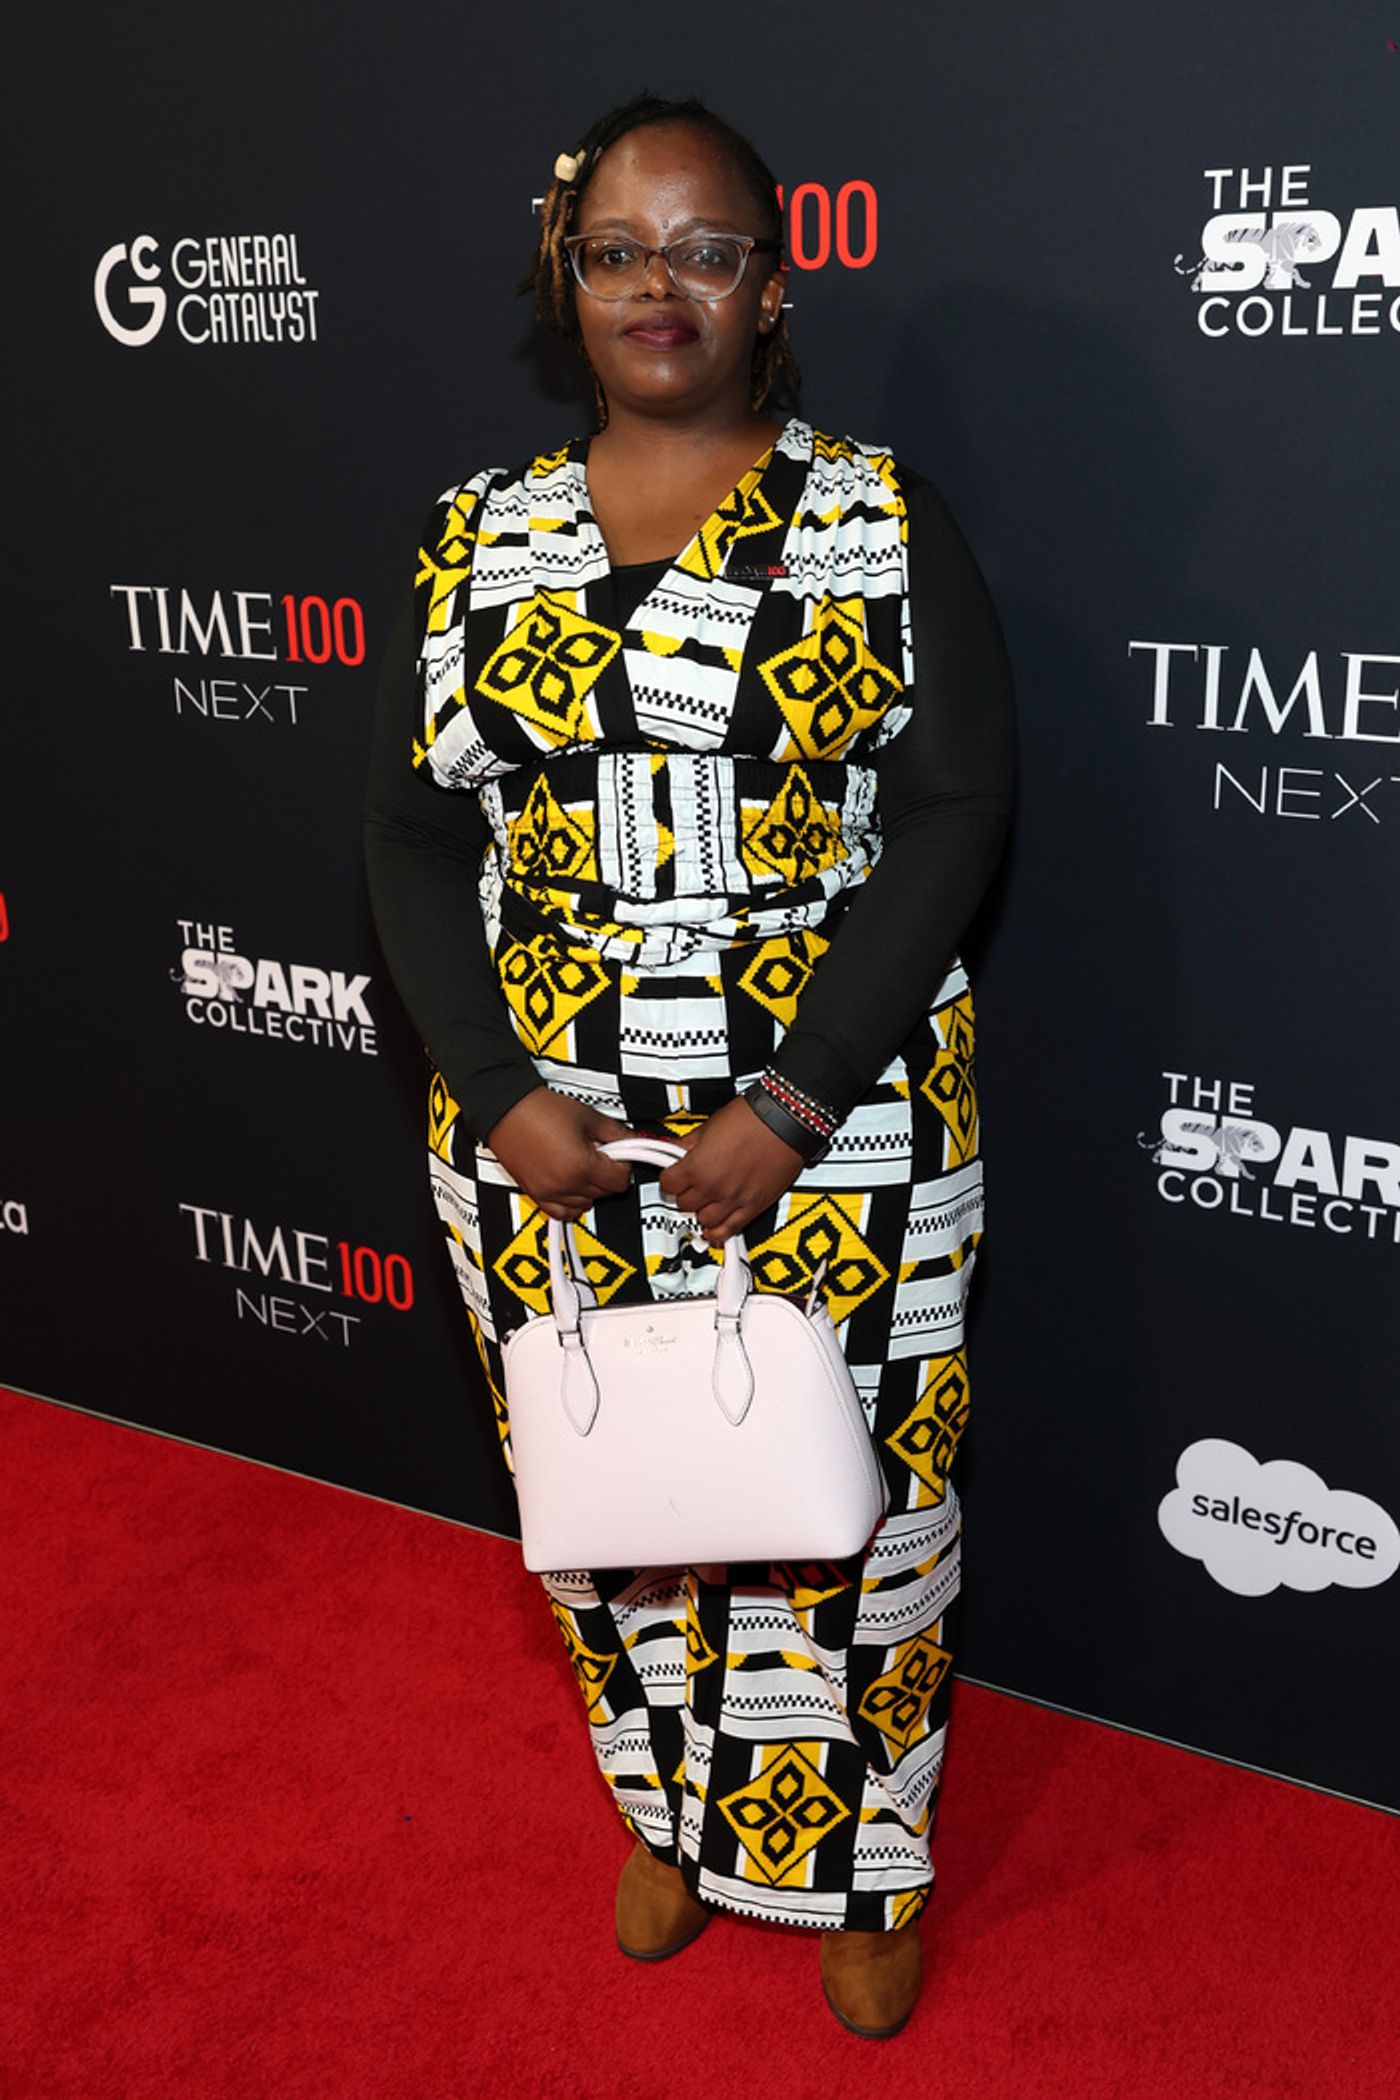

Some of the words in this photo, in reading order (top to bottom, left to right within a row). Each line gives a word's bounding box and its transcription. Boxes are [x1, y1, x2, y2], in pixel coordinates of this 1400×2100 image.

[1204, 165, 1311, 209] THE
[172, 234, 306, 289] GENERAL
[177, 291, 319, 344] CATALYST
[174, 677, 308, 724] NEXT
[1128, 641, 1400, 743] TIME
[1214, 762, 1400, 824] NEX
[177, 919, 235, 952] THE
[181, 948, 374, 1027] SPARK
[186, 998, 378, 1056] COLLECTIVE
[1162, 1071, 1255, 1117] THE
[1160, 1107, 1400, 1208] SPAR
[236, 1288, 360, 1346] NEXT
[1192, 1495, 1377, 1560] salesforce
